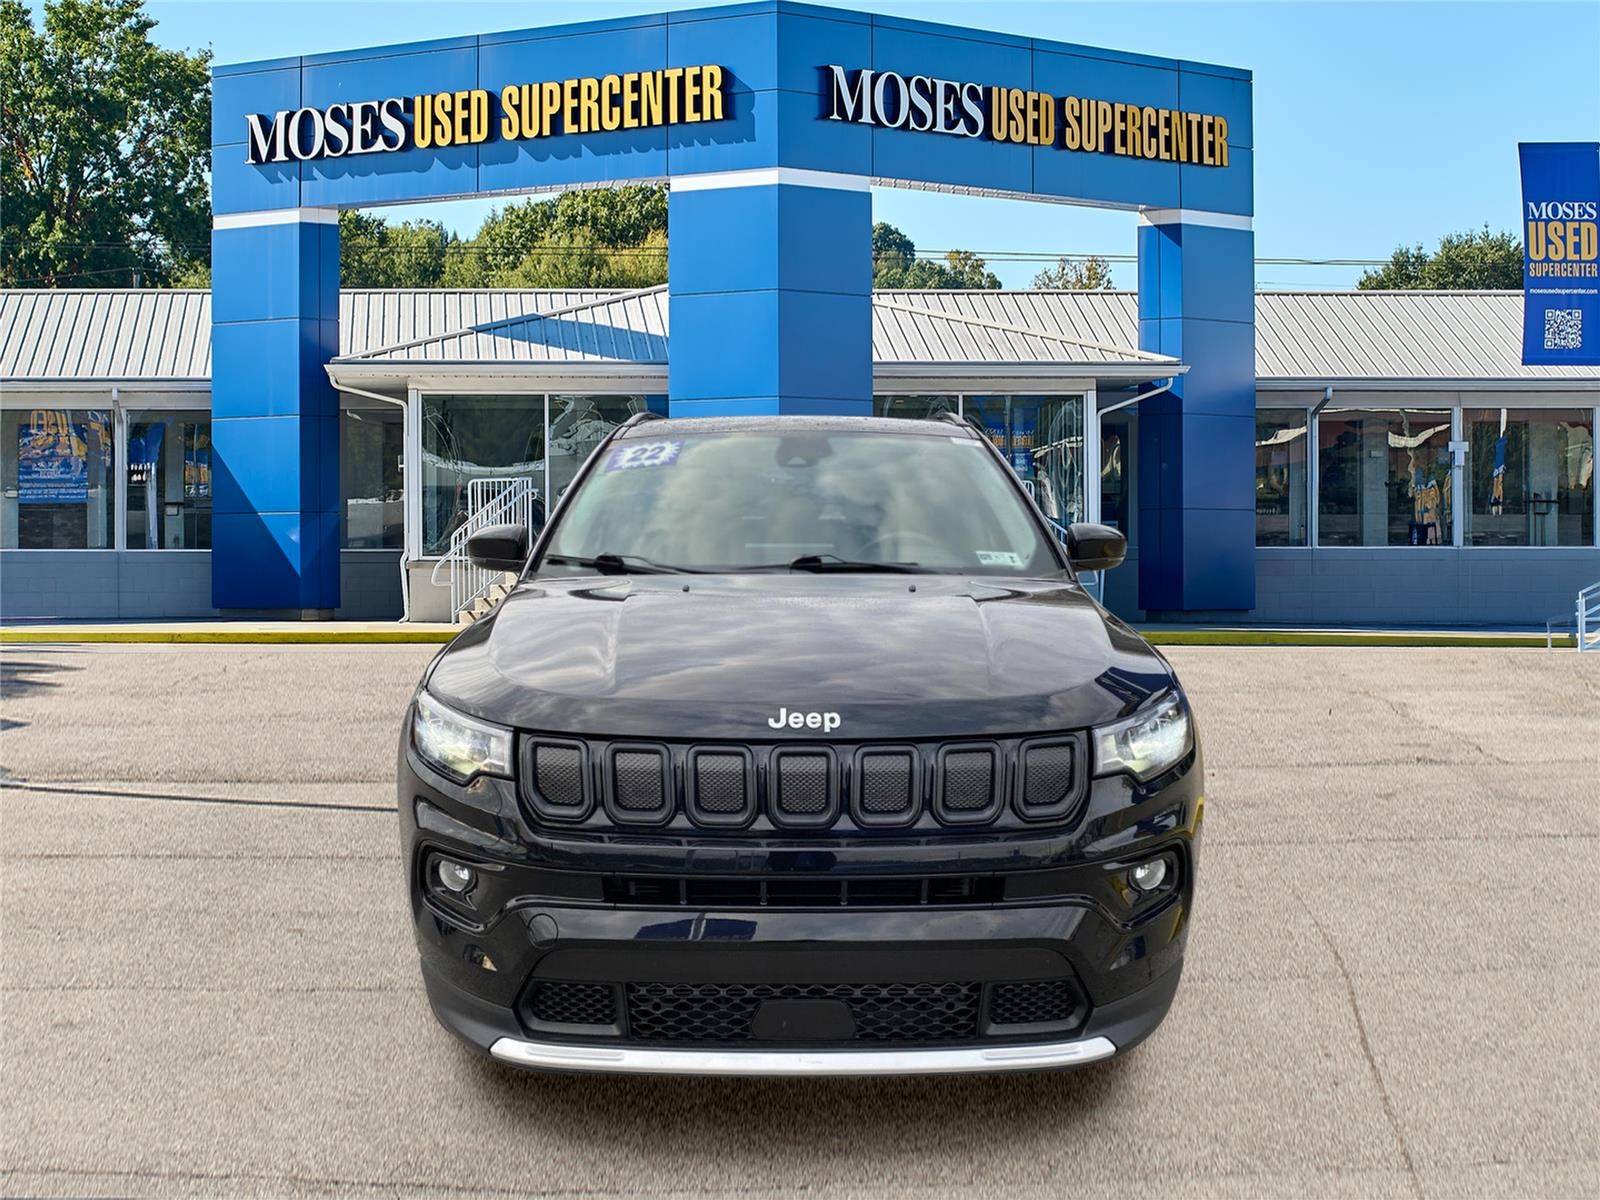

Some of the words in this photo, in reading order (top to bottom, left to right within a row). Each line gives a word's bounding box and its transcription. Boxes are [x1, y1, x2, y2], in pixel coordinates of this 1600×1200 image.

[245, 98, 406, 165] MOSES
[413, 89, 489, 149] USED
[500, 64, 724, 141] SUPERCENTER
[829, 65, 985, 137] MOSES
[991, 87, 1055, 146] USED
[1063, 95, 1229, 167] SUPERCENTER
[1528, 202, 1597, 219] MOSES
[1528, 221, 1598, 261] USED
[1529, 262, 1598, 278] SUPERCENTER
[768, 708, 841, 732] Jeep
